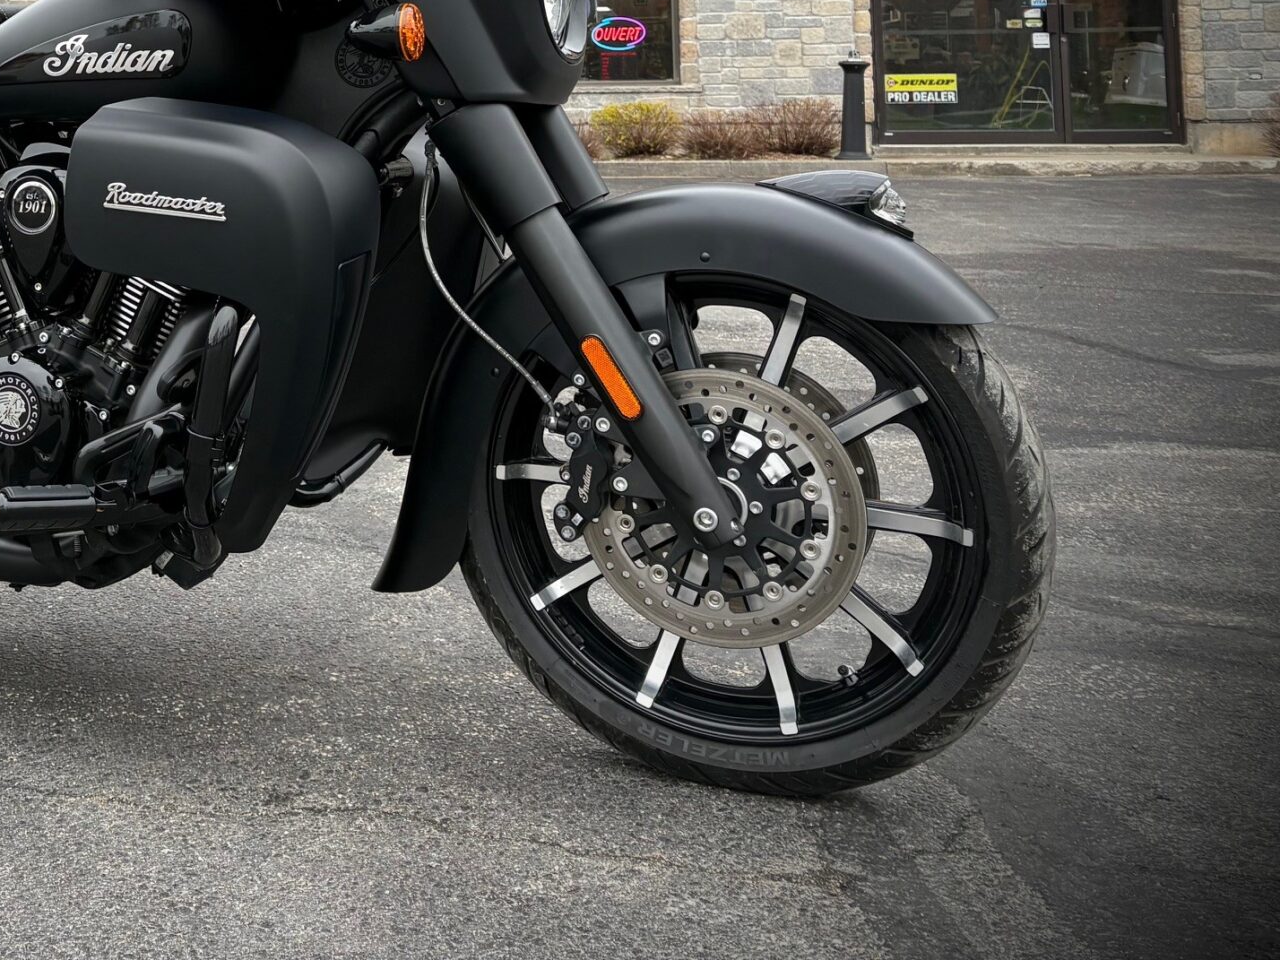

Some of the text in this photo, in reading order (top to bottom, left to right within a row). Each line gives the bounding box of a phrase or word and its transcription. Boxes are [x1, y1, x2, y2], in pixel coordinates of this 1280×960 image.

[594, 27, 642, 41] OUVERT
[43, 34, 174, 76] Indian
[887, 91, 956, 102] PRO DEALER
[18, 200, 47, 214] 1901
[25, 191, 40, 200] est.
[103, 182, 226, 221] Roadmaster
[0, 377, 38, 432] MOTORCYCLE
[578, 464, 593, 503] Indian
[637, 721, 791, 766] METZELER
